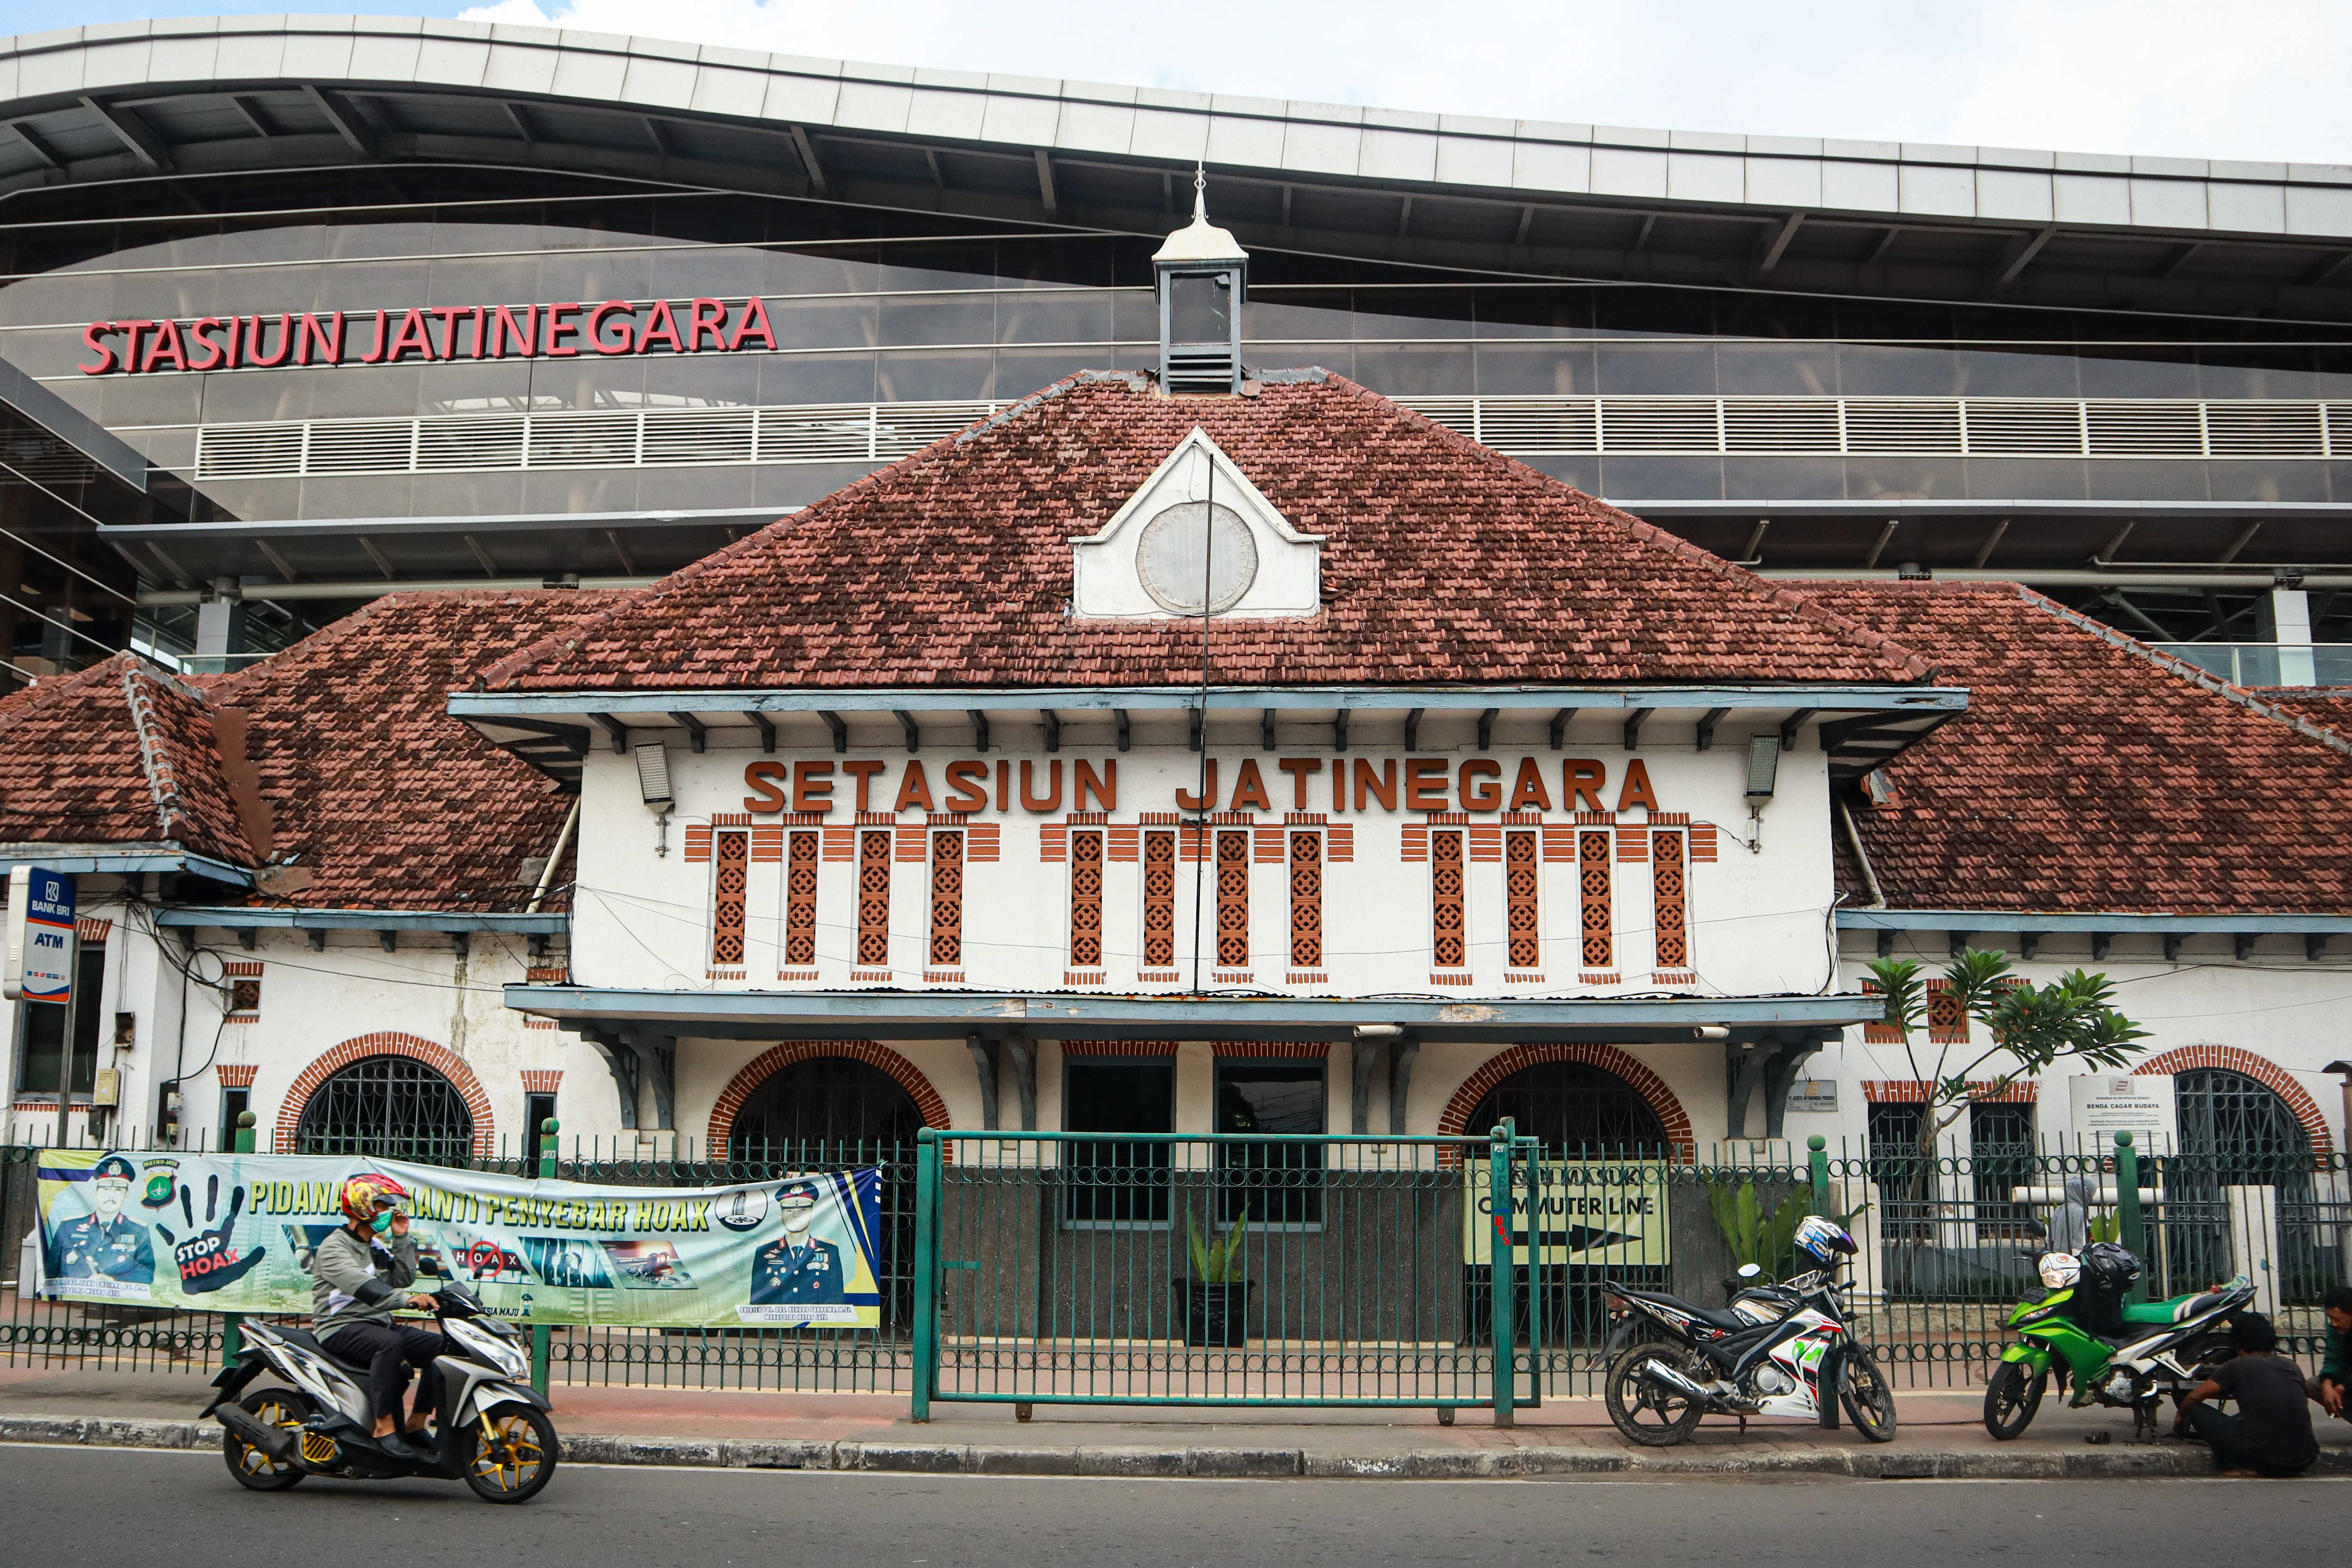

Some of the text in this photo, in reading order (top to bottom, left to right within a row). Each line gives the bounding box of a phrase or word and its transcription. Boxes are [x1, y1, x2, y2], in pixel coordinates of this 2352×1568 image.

[78, 296, 778, 375] STASIUN JATINEGARA
[743, 757, 1659, 812] SETASIUN JATINEGARA
[32, 900, 70, 916] BANK BRI
[34, 933, 63, 949] ATM
[485, 1194, 628, 1232] PENYEBAR
[634, 1201, 711, 1232] HOAX
[1478, 1196, 1653, 1215] CMMUTER LINE
[177, 1236, 221, 1262] STOP
[456, 1251, 517, 1265] HOAX
[179, 1248, 240, 1280] HOAX
[499, 1308, 519, 1317] MAJU
